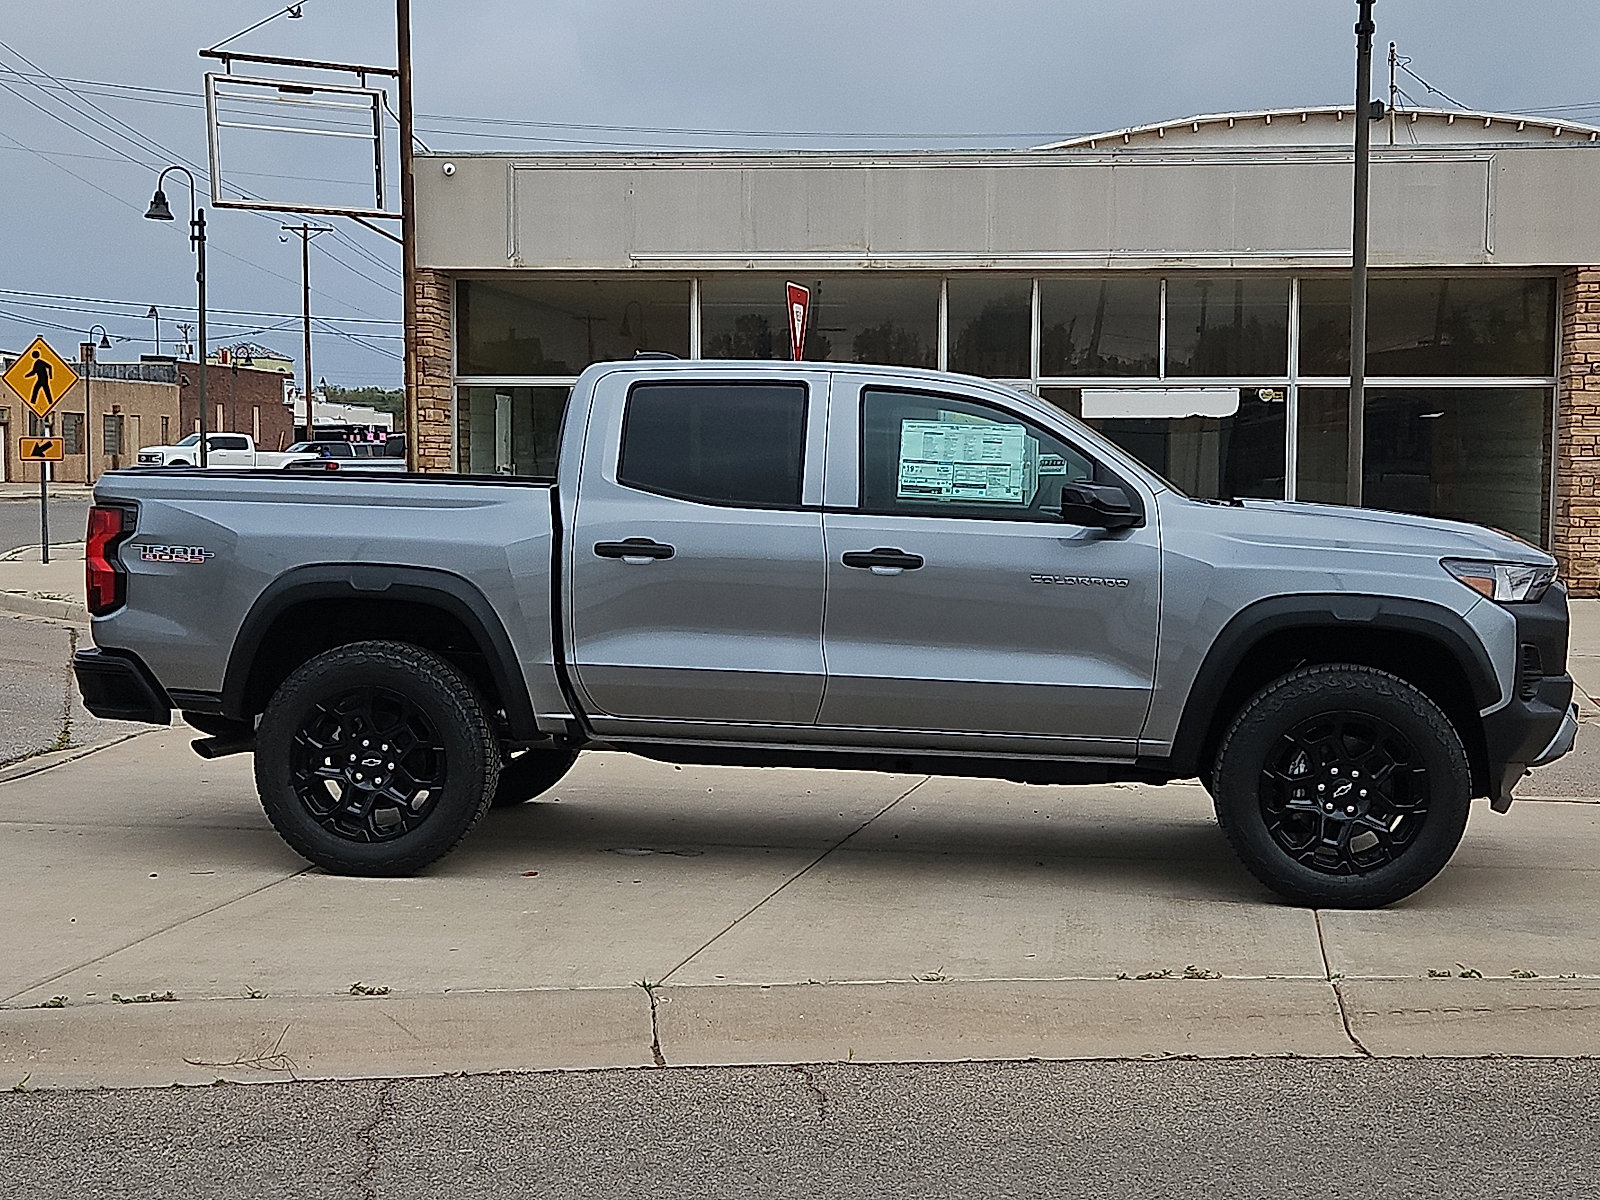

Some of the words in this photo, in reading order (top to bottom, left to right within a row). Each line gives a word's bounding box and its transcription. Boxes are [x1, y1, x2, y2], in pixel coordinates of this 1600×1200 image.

[130, 543, 215, 558] TRAIL
[141, 553, 204, 563] BOSS
[1030, 573, 1129, 588] COLORADO
